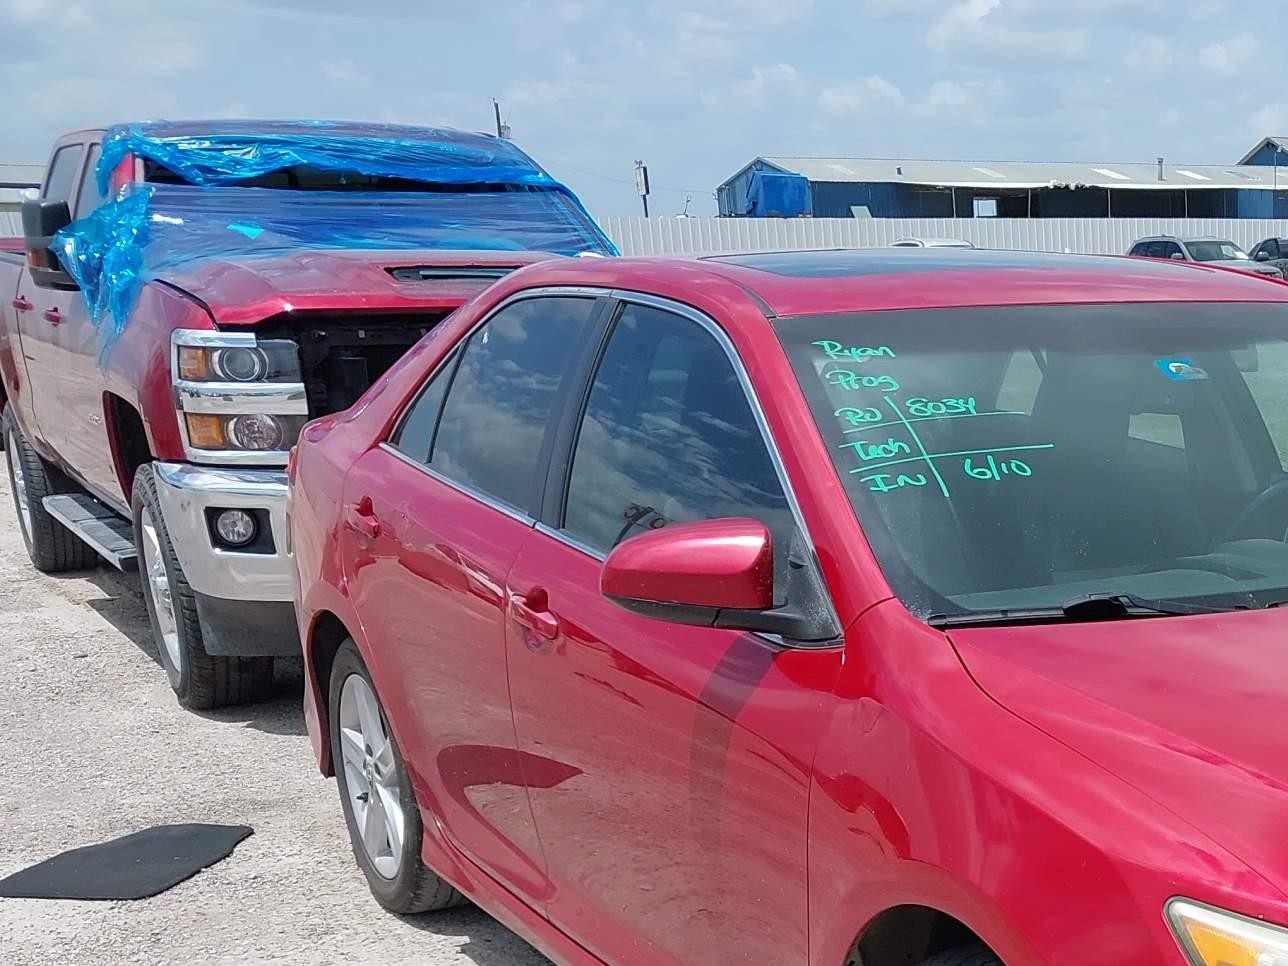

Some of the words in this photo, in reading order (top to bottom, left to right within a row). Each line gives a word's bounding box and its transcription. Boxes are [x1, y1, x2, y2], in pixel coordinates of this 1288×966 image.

[811, 340, 897, 363] Ryan
[905, 396, 977, 416] 8034
[963, 455, 1032, 482] 6/10
